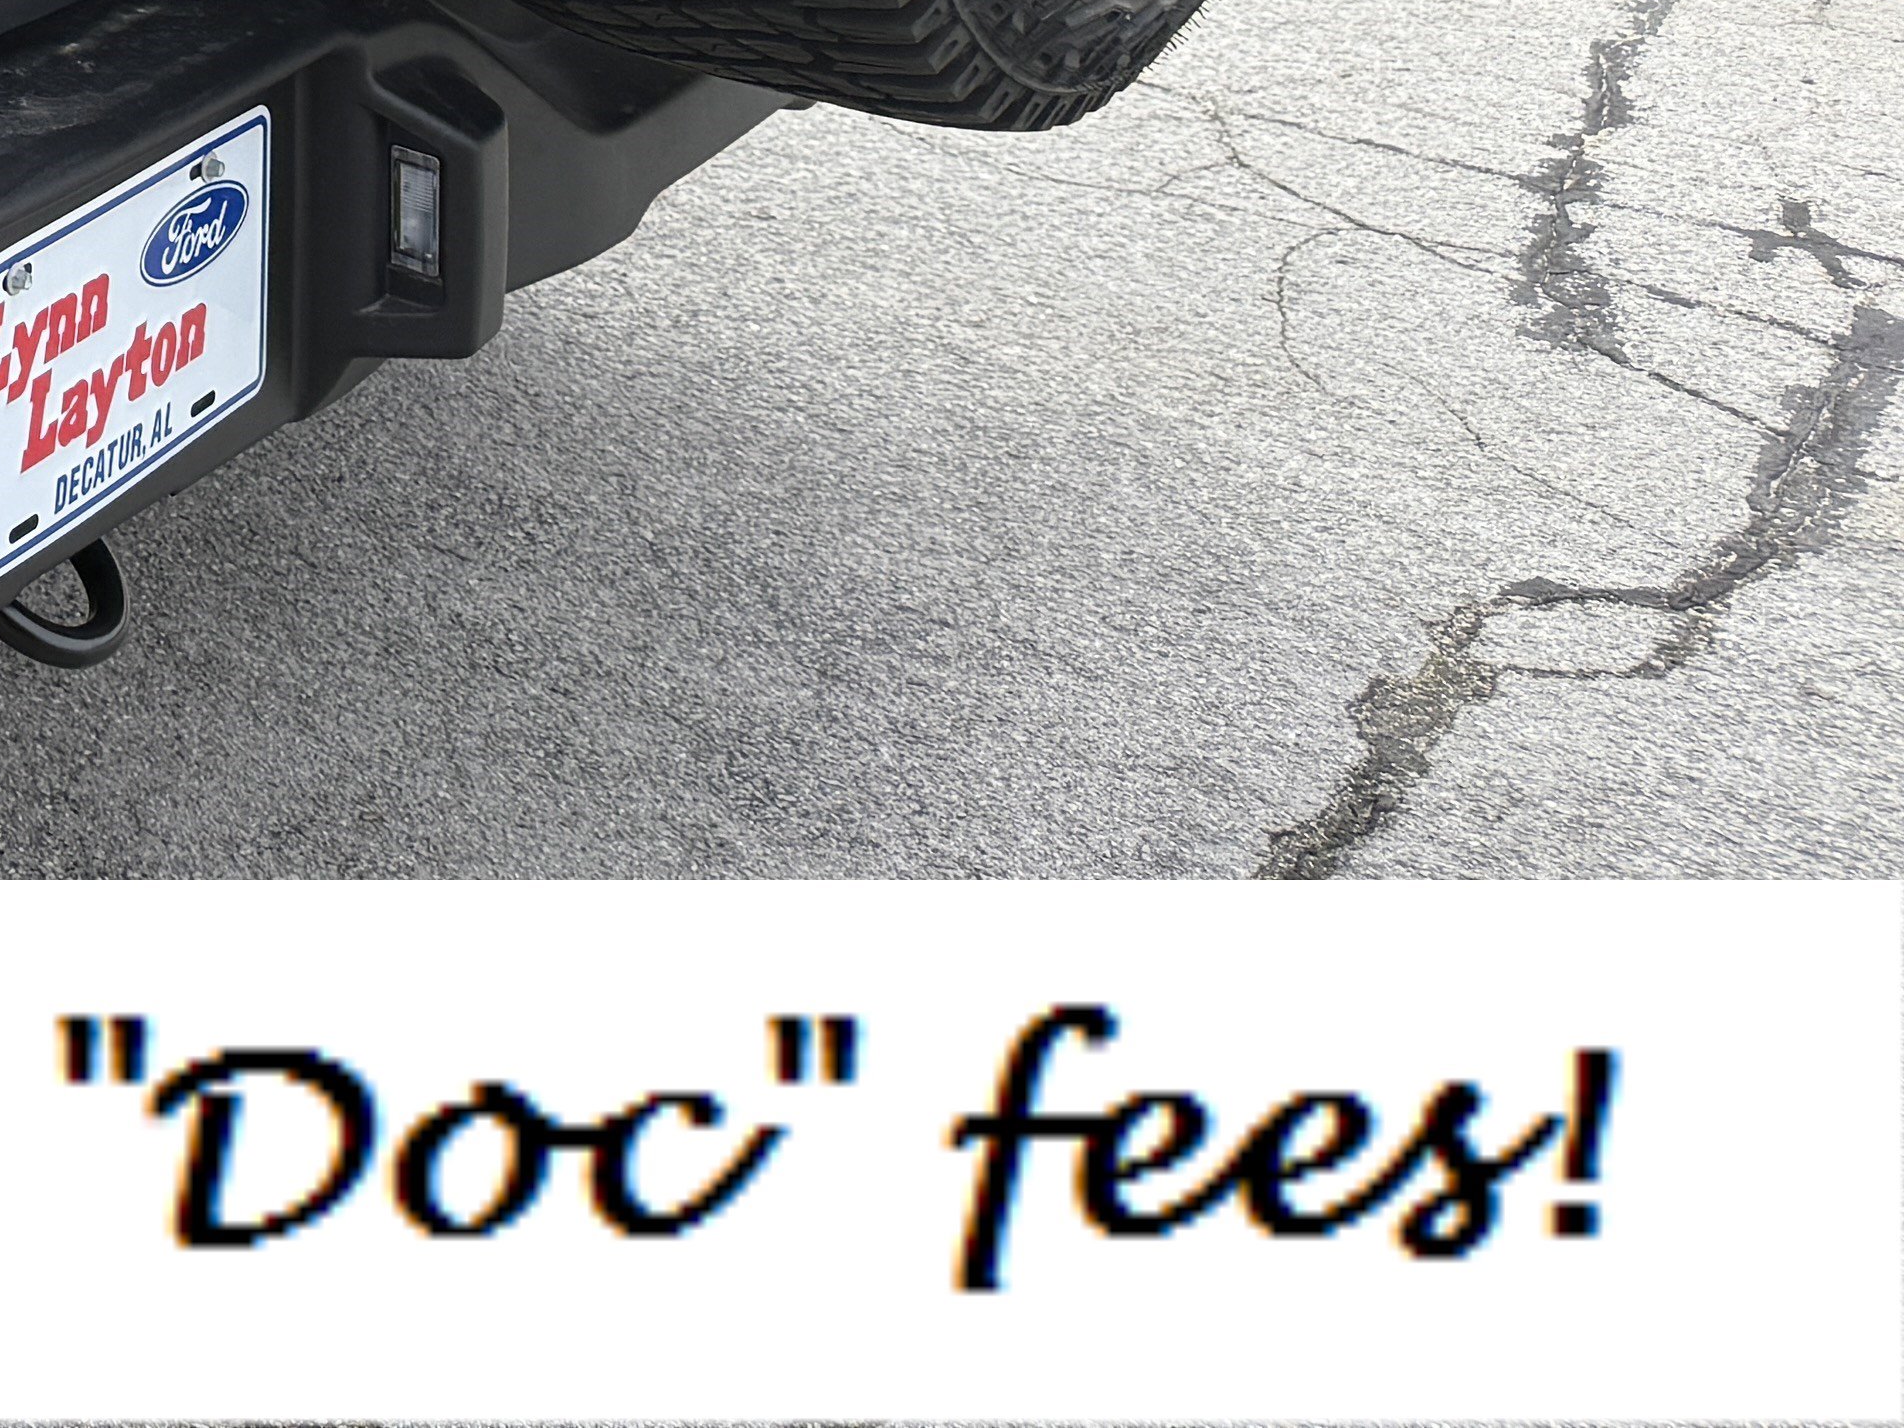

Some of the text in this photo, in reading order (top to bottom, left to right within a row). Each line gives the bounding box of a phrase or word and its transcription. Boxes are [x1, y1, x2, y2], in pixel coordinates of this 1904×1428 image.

[162, 196, 226, 276] Ford
[19, 301, 207, 475] Layton
[53, 401, 174, 516] DECATUR, AL
